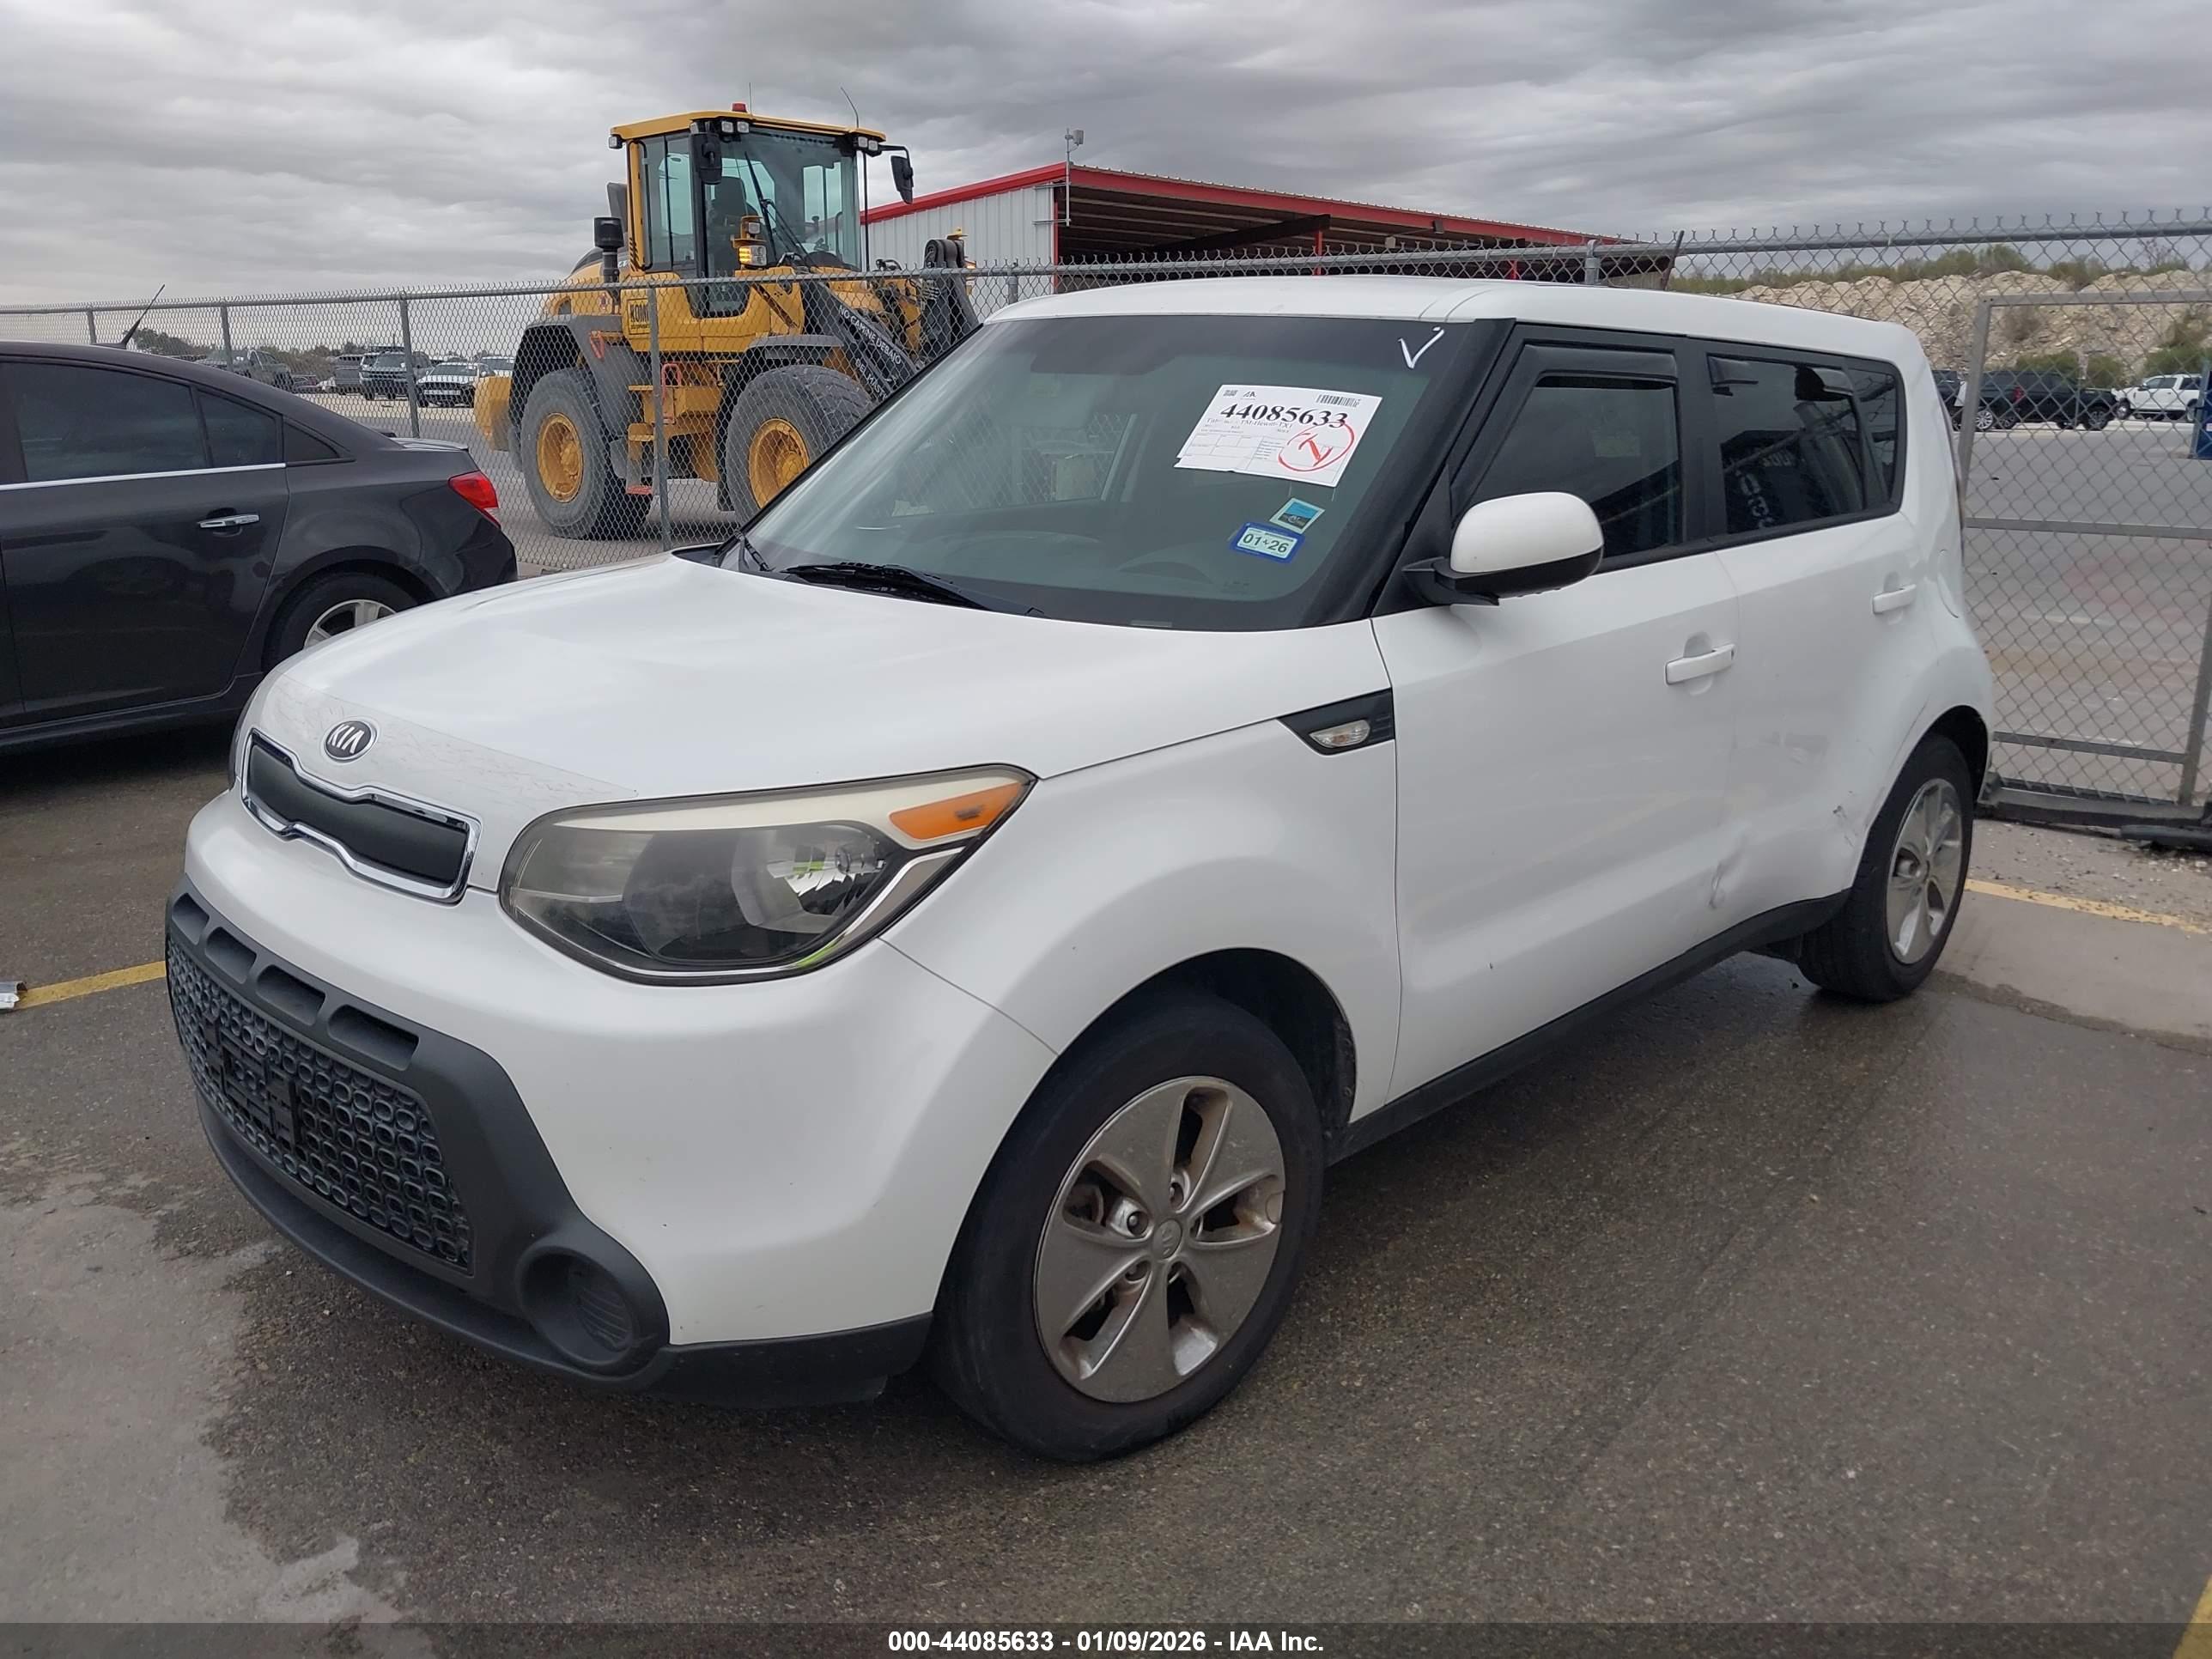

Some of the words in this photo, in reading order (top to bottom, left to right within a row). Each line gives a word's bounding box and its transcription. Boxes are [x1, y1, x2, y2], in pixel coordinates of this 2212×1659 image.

[876, 337, 902, 364] DEBAJO
[1220, 403, 1348, 428] 44085633
[326, 723, 365, 754] KIA
